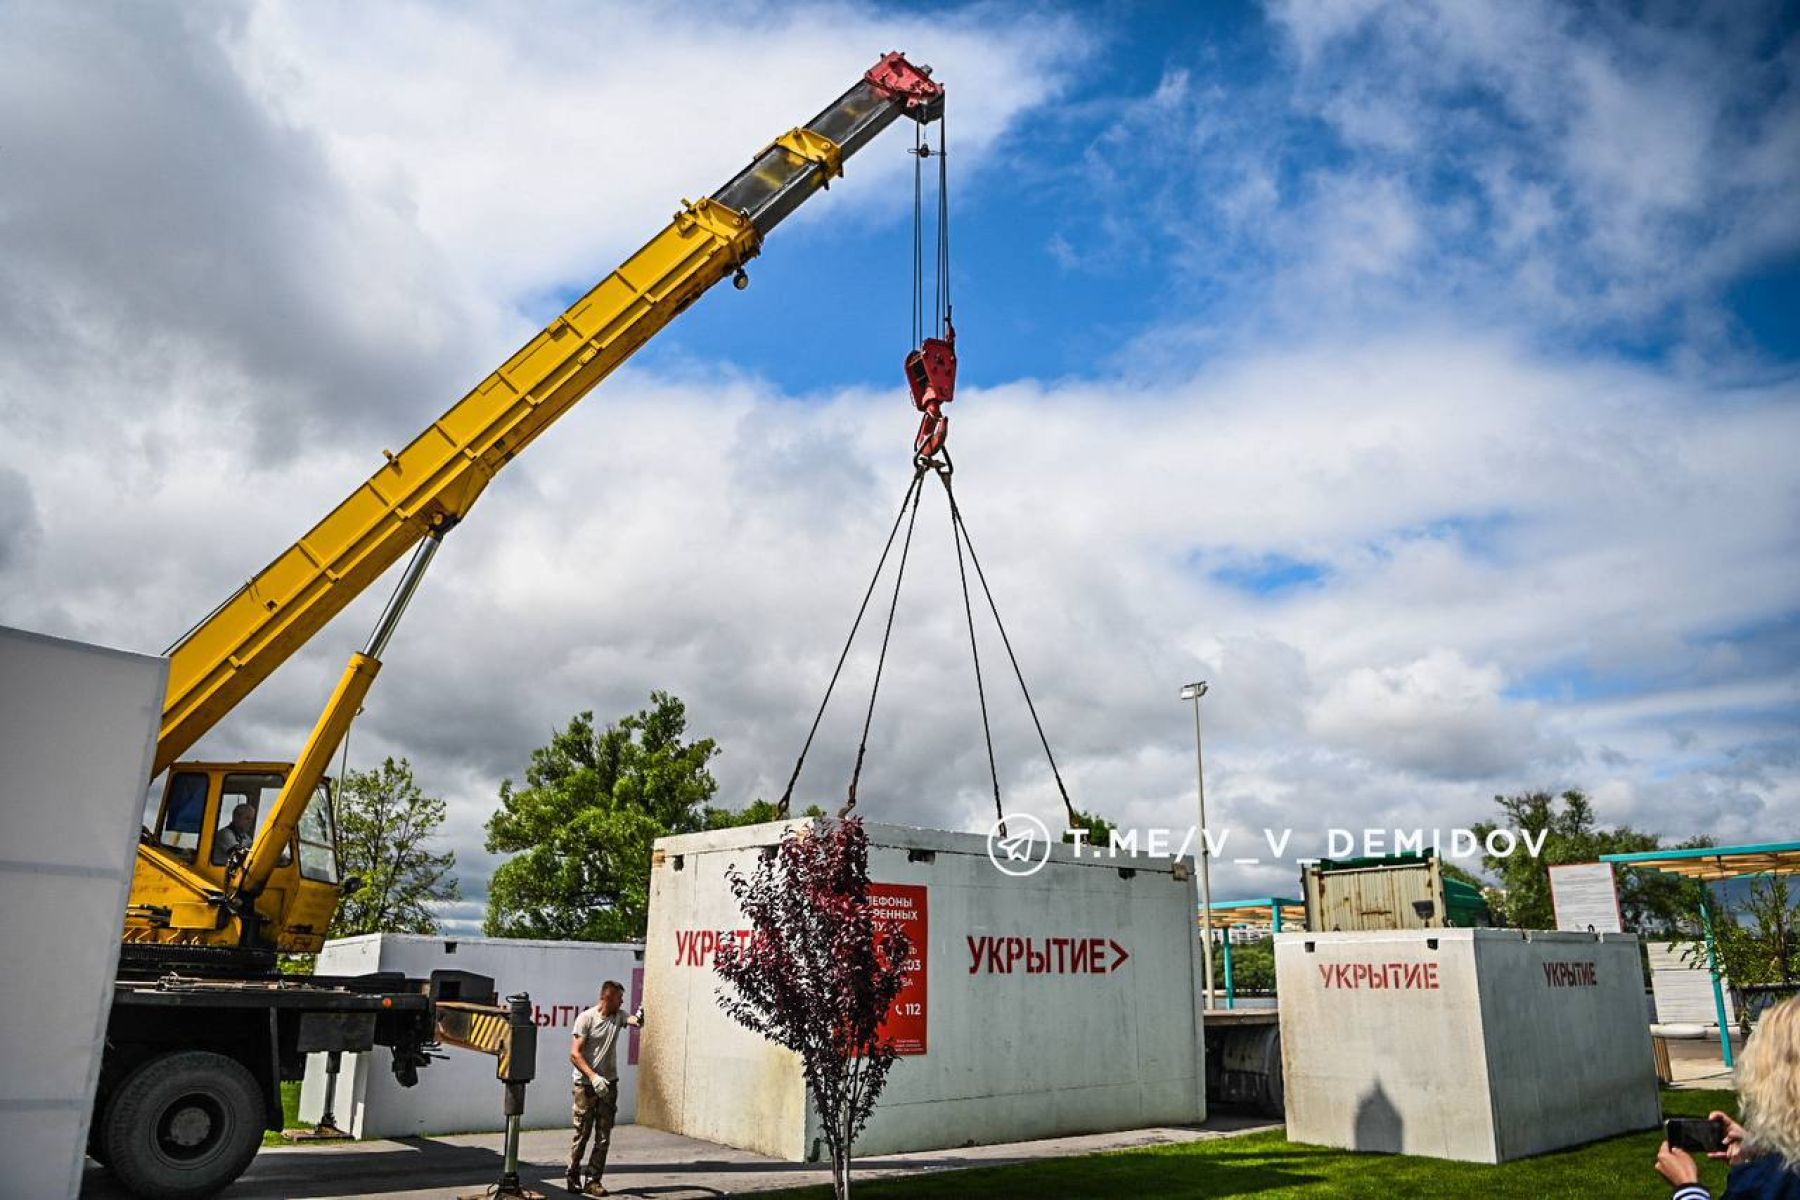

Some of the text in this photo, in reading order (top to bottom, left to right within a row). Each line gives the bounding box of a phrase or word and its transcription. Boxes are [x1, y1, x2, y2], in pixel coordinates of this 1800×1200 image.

[869, 909, 918, 920] РЕННЫХ
[1319, 963, 1440, 989] УКРЫТИЕ
[1543, 962, 1598, 987] УКРЫТИЕ
[905, 1003, 921, 1015] 112
